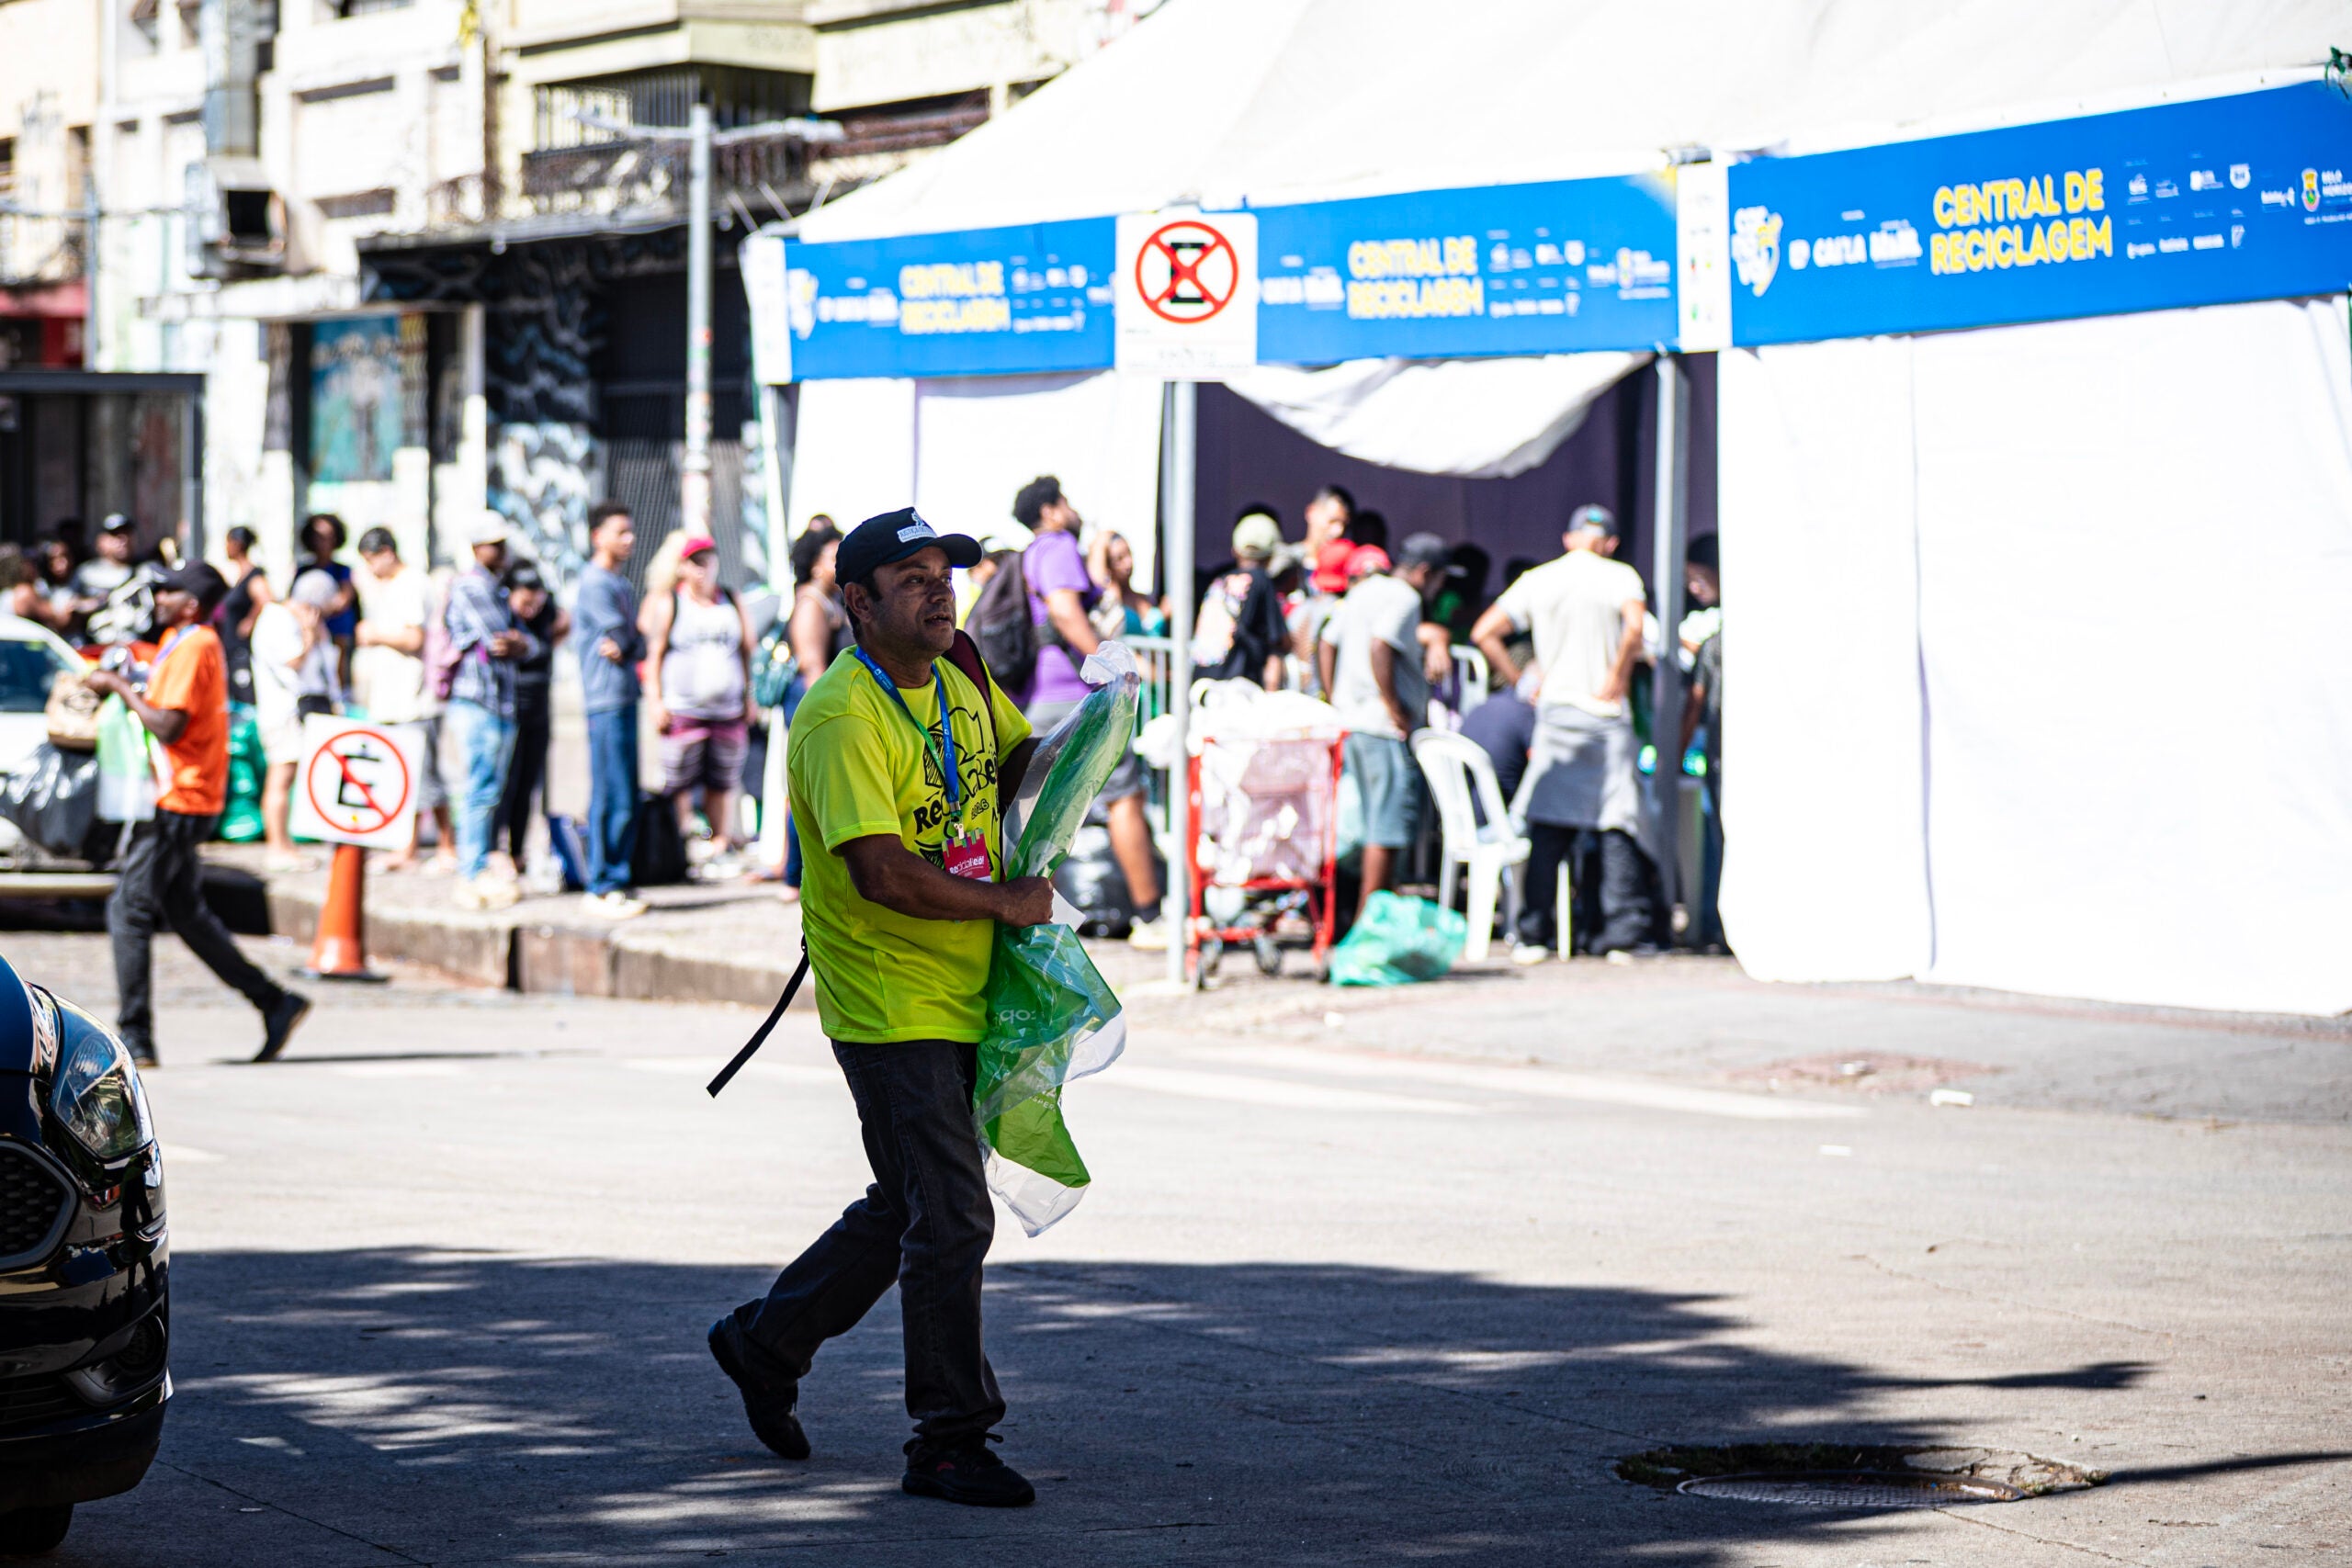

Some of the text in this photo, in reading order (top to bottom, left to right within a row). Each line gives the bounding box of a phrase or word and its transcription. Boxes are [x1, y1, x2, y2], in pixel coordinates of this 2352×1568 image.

[1933, 174, 2062, 229] CENTRAL
[2064, 167, 2105, 213] DE
[1348, 237, 1443, 279] CENTRAL
[1443, 235, 1478, 276] DE
[1930, 215, 2112, 276] RECICLAGEM
